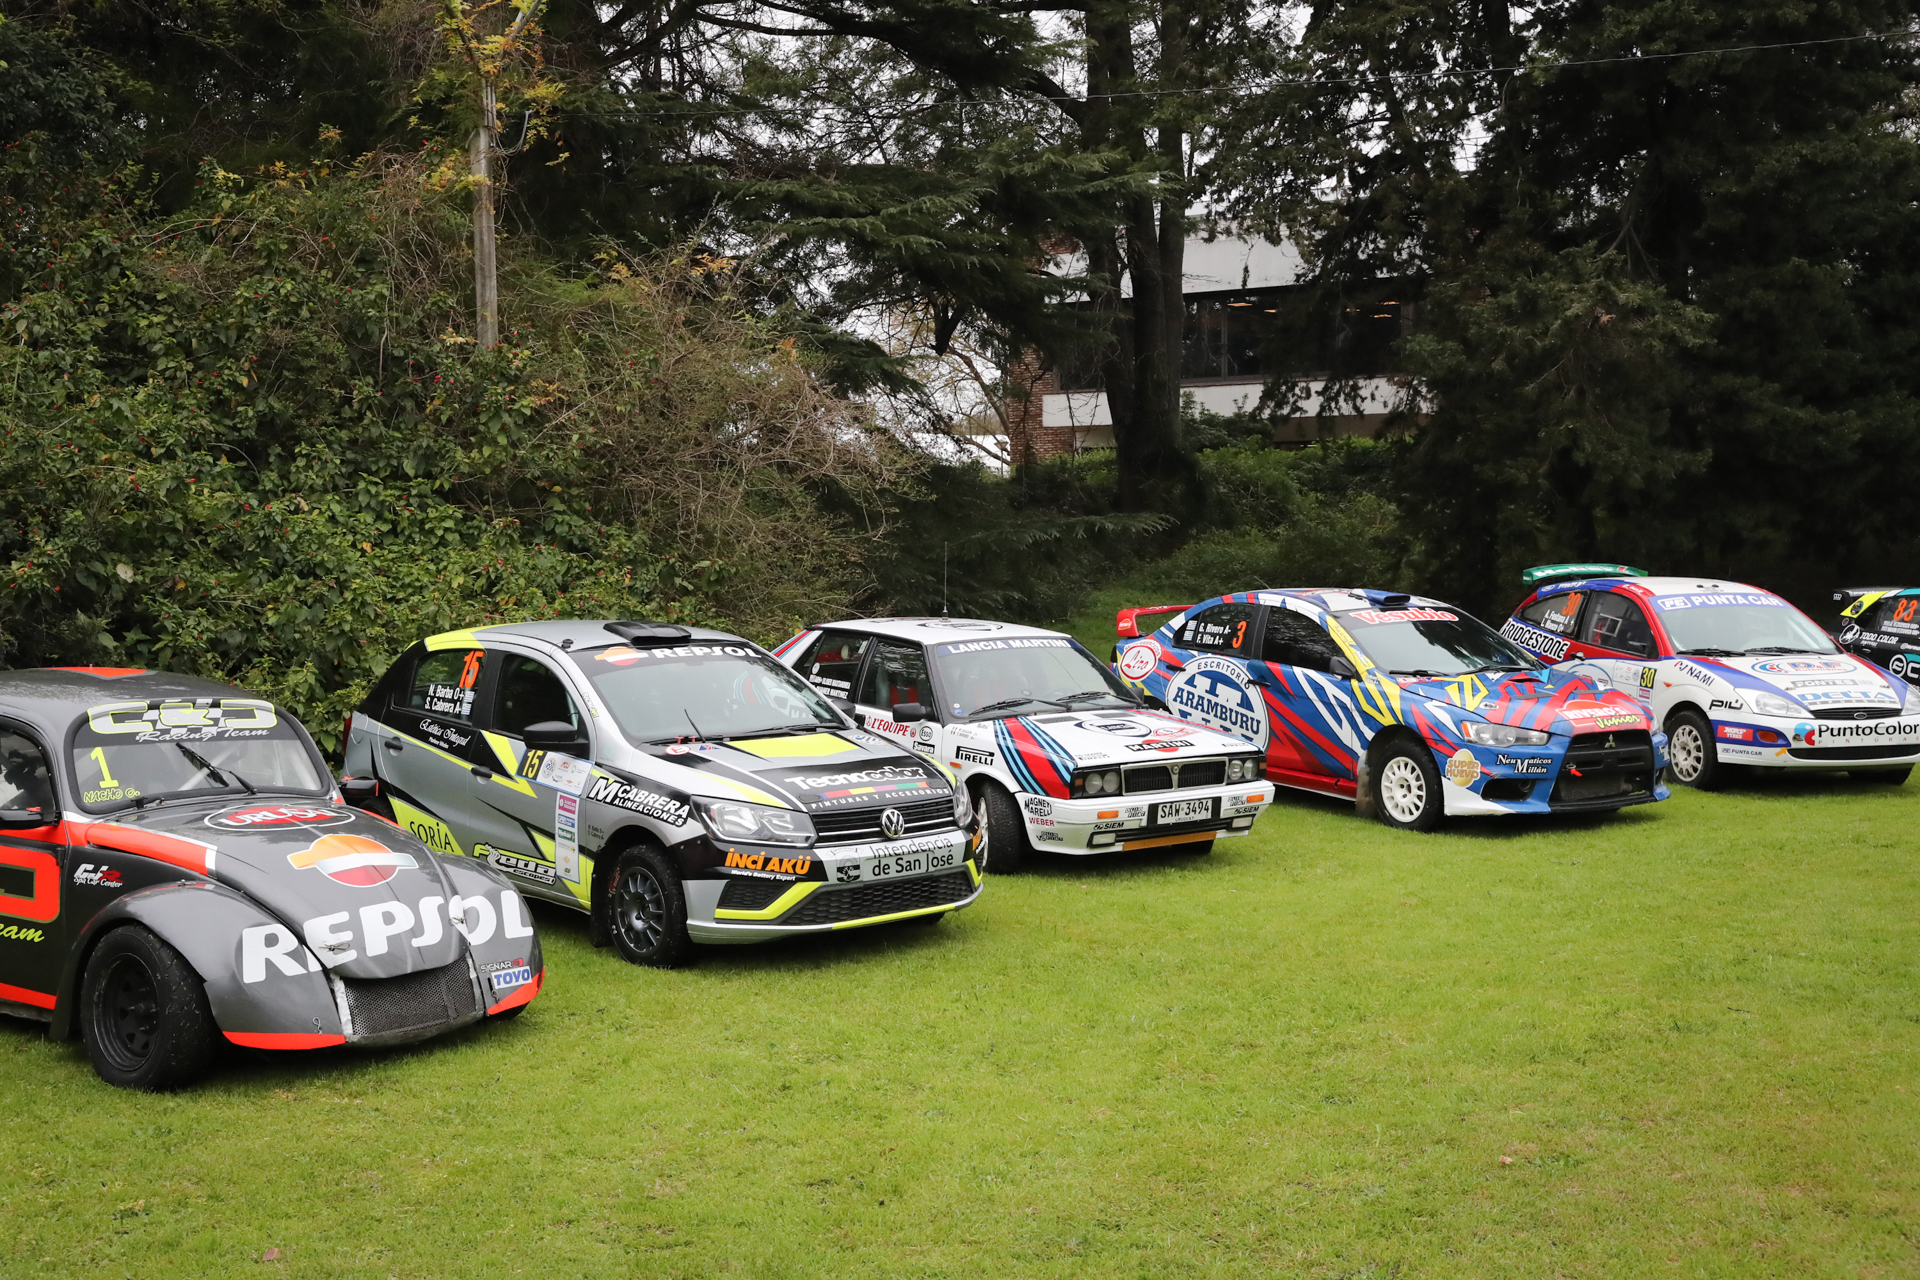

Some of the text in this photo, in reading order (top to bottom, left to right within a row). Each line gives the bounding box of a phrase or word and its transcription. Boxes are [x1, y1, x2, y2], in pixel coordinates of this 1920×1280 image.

[1562, 592, 1582, 616] 30
[1689, 595, 1749, 606] PUNTA
[1747, 596, 1784, 607] CAR
[1350, 608, 1458, 624] Vesubio
[1893, 599, 1918, 622] 83
[1205, 623, 1224, 633] Rivero
[1232, 620, 1247, 649] 3
[947, 639, 1072, 654] LANCIA MARTINI
[1202, 635, 1213, 645] Vita
[1213, 636, 1223, 646] A+
[650, 646, 762, 659] REPSOL
[459, 650, 485, 688] 15
[1197, 660, 1250, 690] ESCRITORIO
[1640, 668, 1655, 687] 30
[436, 684, 453, 698] Barba
[1797, 690, 1896, 701] DELTA
[432, 697, 454, 712] Cabrera
[1173, 686, 1261, 735] ARAMBURU
[137, 728, 270, 743] Racing Team
[1724, 726, 1747, 735] MRF
[1818, 721, 1920, 738] PuntoColor
[1128, 740, 1192, 752] MARTINI
[522, 749, 544, 778] 15
[955, 745, 996, 766] PIRELLI
[90, 746, 119, 789] 1
[1447, 759, 1480, 770] SUPER
[784, 766, 928, 790] Tecnocolor
[1446, 768, 1480, 779] HUEVO
[83, 788, 123, 803] NACHO
[617, 785, 691, 819] CABRERA
[811, 795, 870, 810] PINTURAS
[885, 788, 950, 798] ACCESORIOS
[613, 797, 685, 827] ALINEACIONES
[1185, 800, 1210, 816] 3494
[1029, 817, 1054, 827] WEBER
[869, 836, 953, 859] Intendencia
[765, 855, 811, 875] AKÜ
[872, 850, 954, 876] de San José
[242, 889, 534, 984] REPSOL
[495, 969, 531, 986] TOYO
